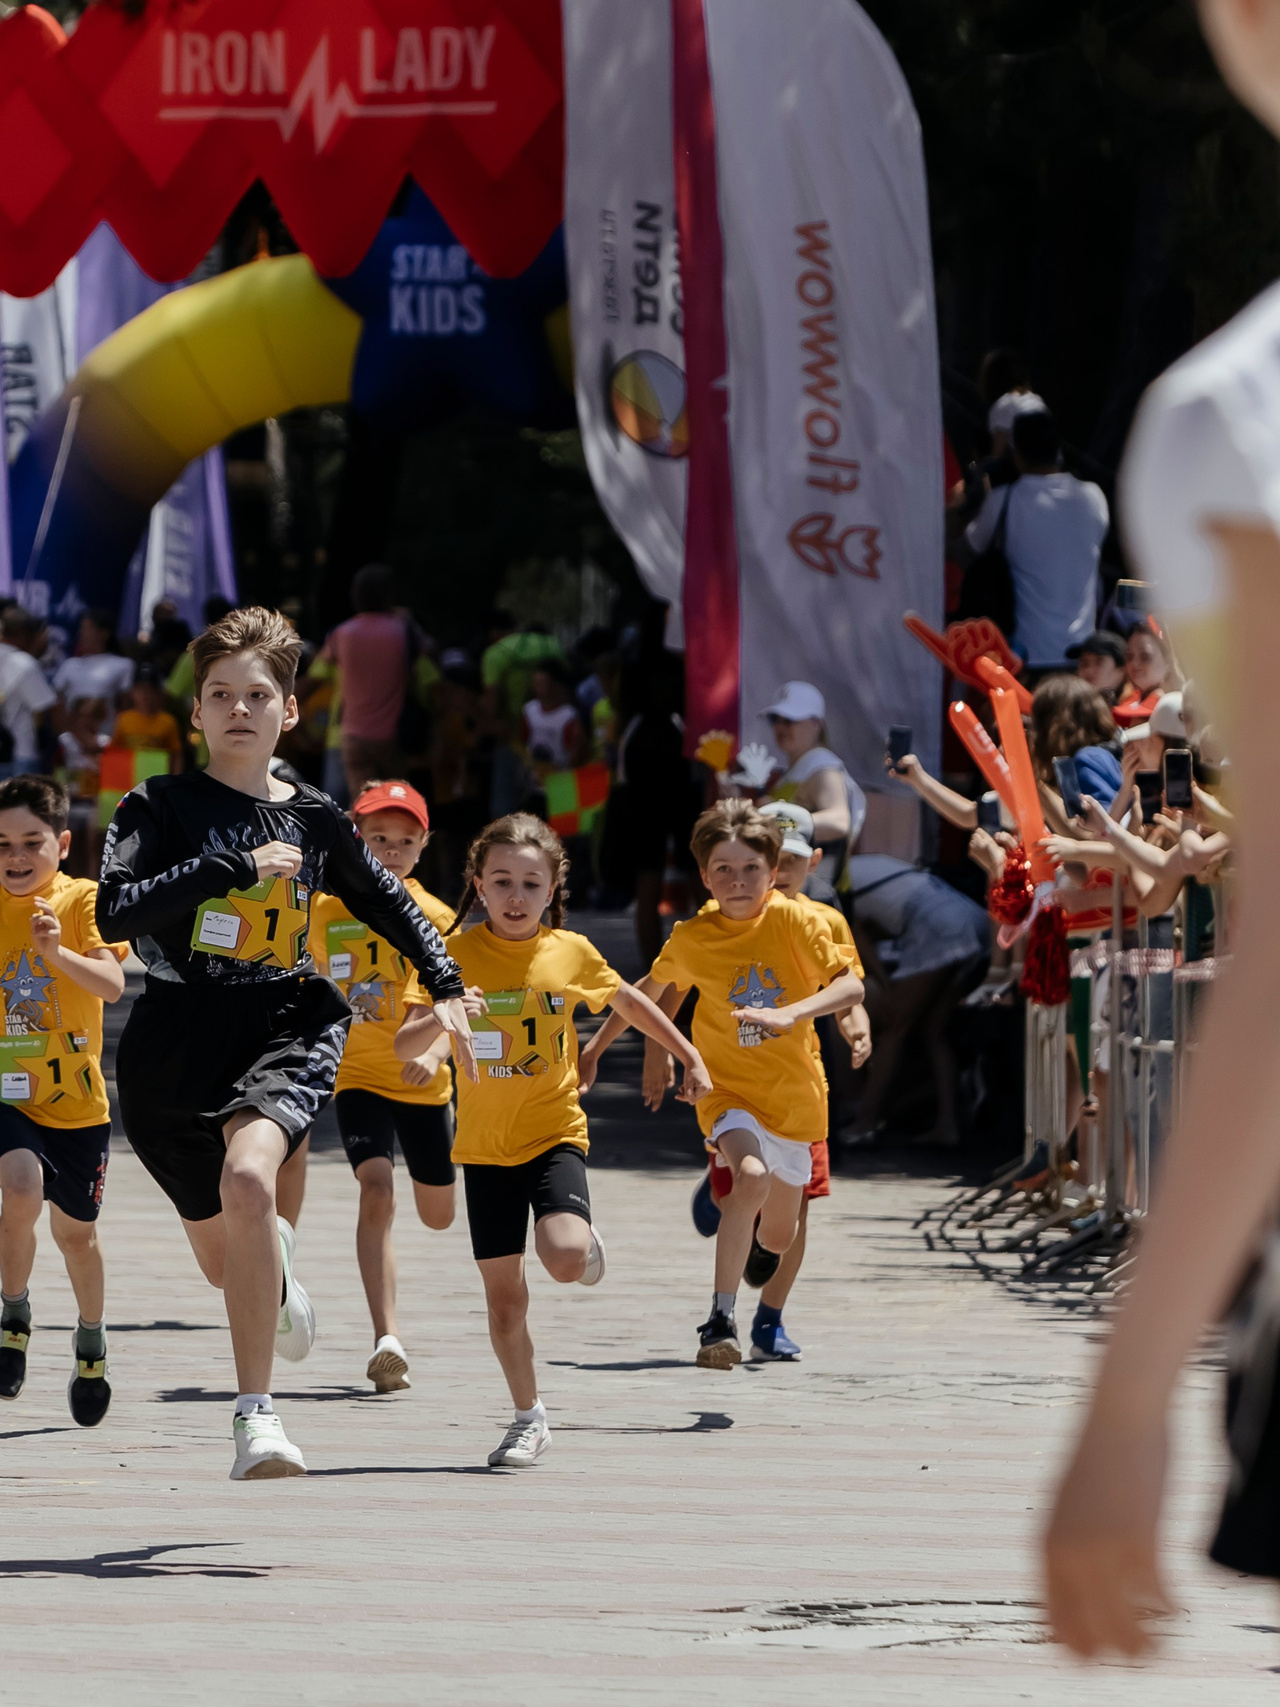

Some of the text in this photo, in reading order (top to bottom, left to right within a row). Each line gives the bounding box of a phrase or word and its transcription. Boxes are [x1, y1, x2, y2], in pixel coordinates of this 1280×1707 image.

[162, 26, 495, 95] IRON LADY
[390, 244, 468, 282] STAR
[390, 286, 486, 334] KIDS
[264, 908, 280, 941] 1
[366, 941, 378, 965] 1
[4, 1014, 22, 1024] STAR
[5, 1024, 29, 1036] KIDS
[521, 1017, 536, 1045] 1
[737, 1026, 755, 1035] STAR
[738, 1034, 762, 1047] KIDS
[46, 1058, 61, 1084] 1
[488, 1065, 513, 1078] KIDS
